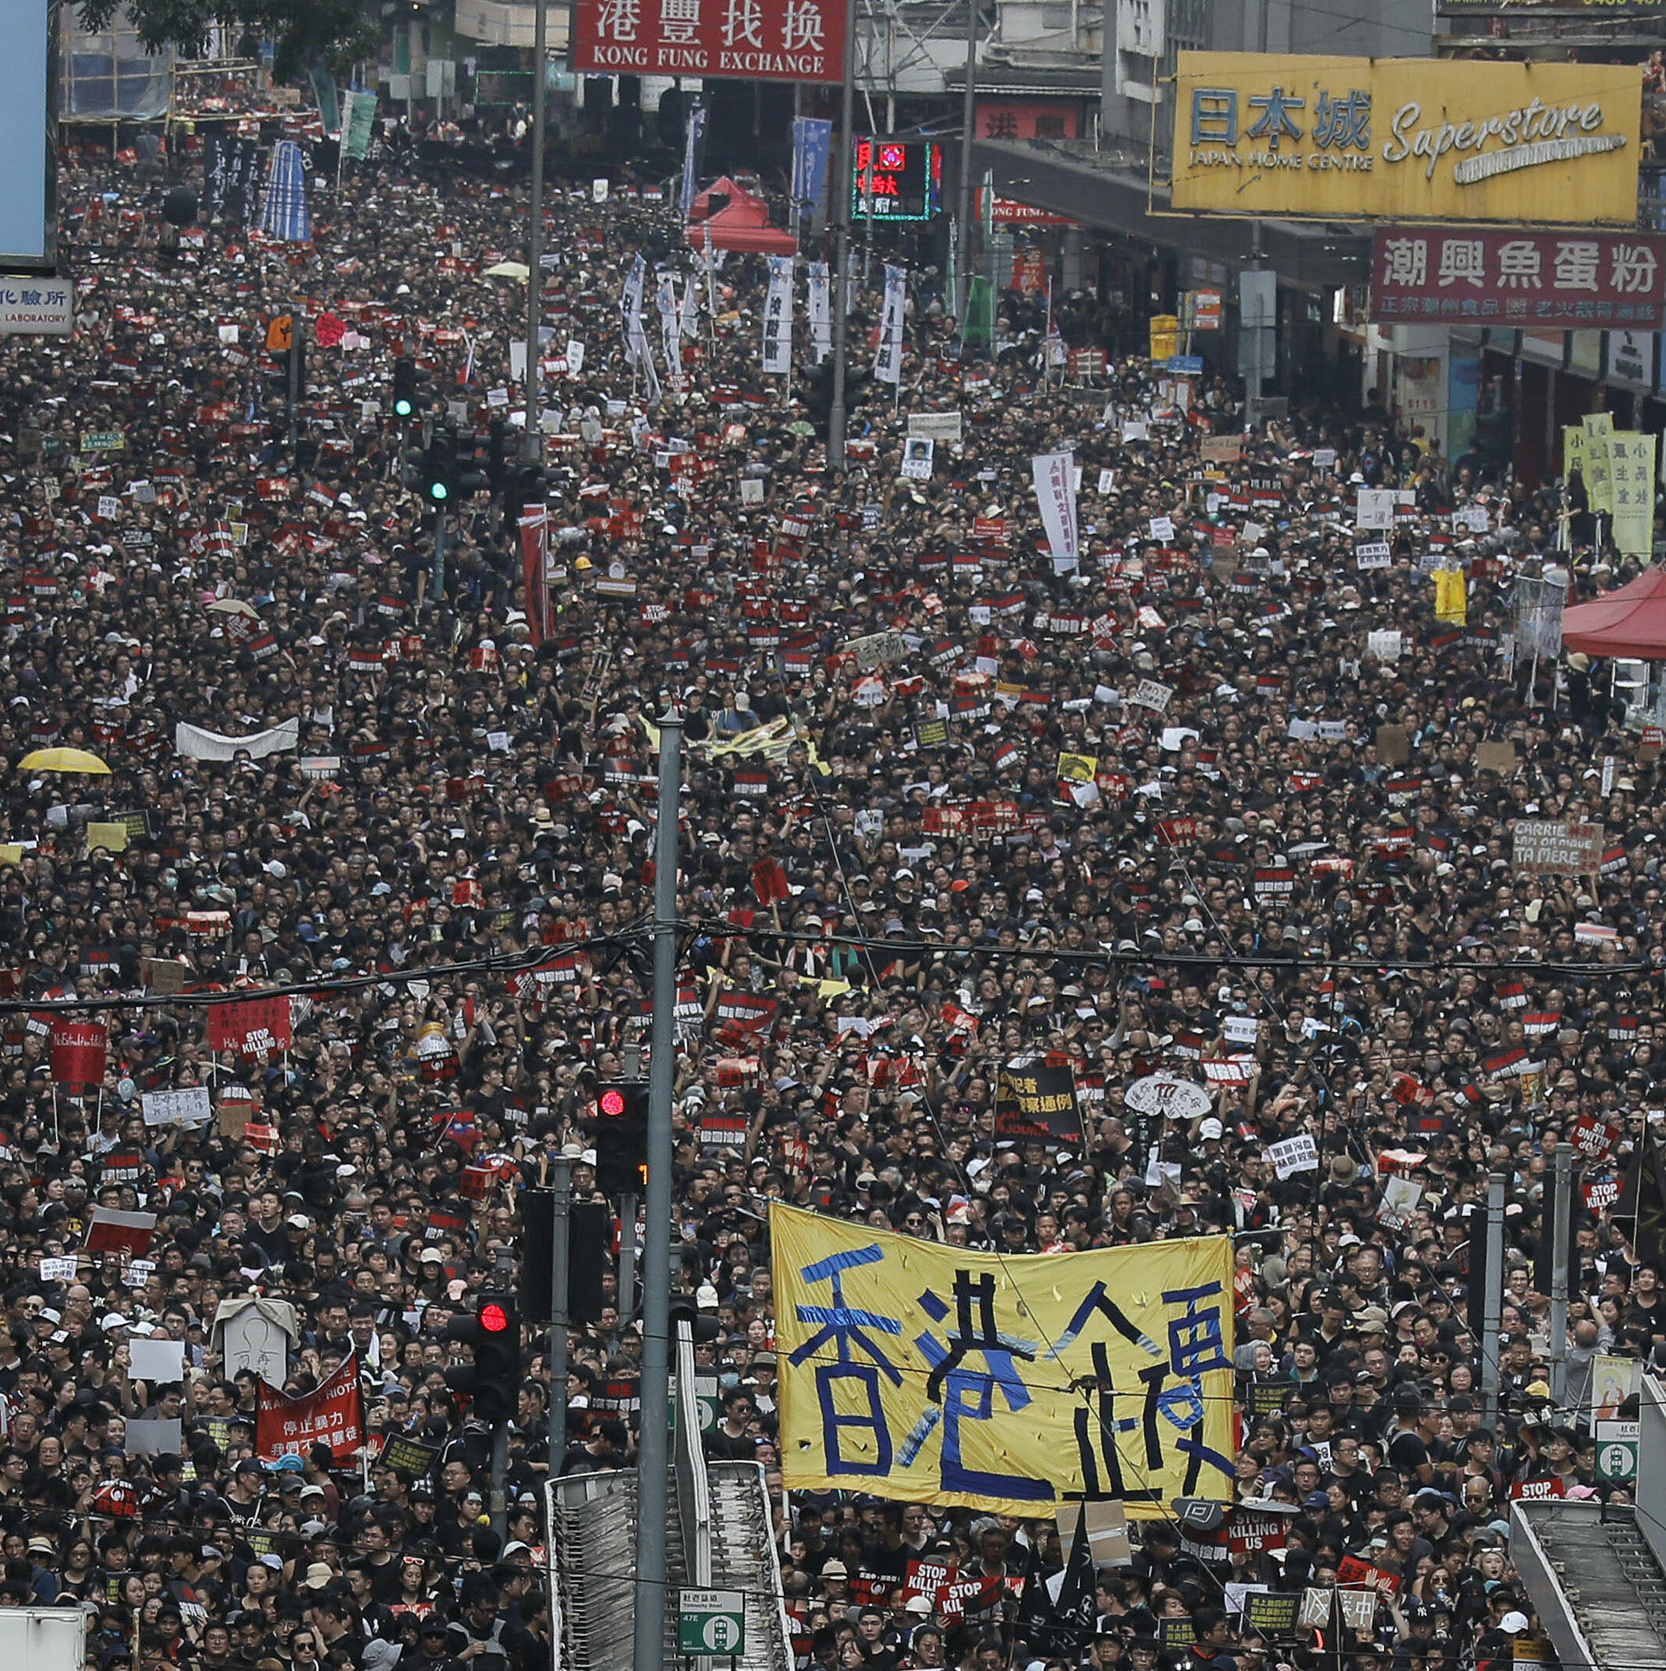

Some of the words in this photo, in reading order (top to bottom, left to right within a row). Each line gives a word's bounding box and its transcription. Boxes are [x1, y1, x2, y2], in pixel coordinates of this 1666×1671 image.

[593, 47, 648, 66] KONG
[657, 48, 708, 69] FUNG
[719, 49, 824, 74] EXCHANGE
[1190, 84, 1373, 150] 日本城
[1382, 95, 1602, 181] Superstore
[1188, 150, 1242, 168] JAPAN
[1248, 151, 1303, 169] HOME
[1308, 152, 1373, 172] CENTRE
[1383, 237, 1658, 294] 潮興魚蛋粉
[5, 312, 67, 323] LABORATORY
[1515, 821, 1567, 839] CARRIE
[244, 1027, 270, 1042] STOP
[240, 1036, 276, 1054] KILLING
[1576, 1125, 1612, 1147] KILLING
[1590, 1183, 1618, 1197] STOP
[283, 1411, 344, 1436] 停止暴力
[1521, 1481, 1552, 1498] STOP
[1228, 1522, 1280, 1539] KILLING
[1244, 1537, 1263, 1550] US
[917, 1563, 947, 1580] STOP
[948, 1582, 983, 1600] STOP
